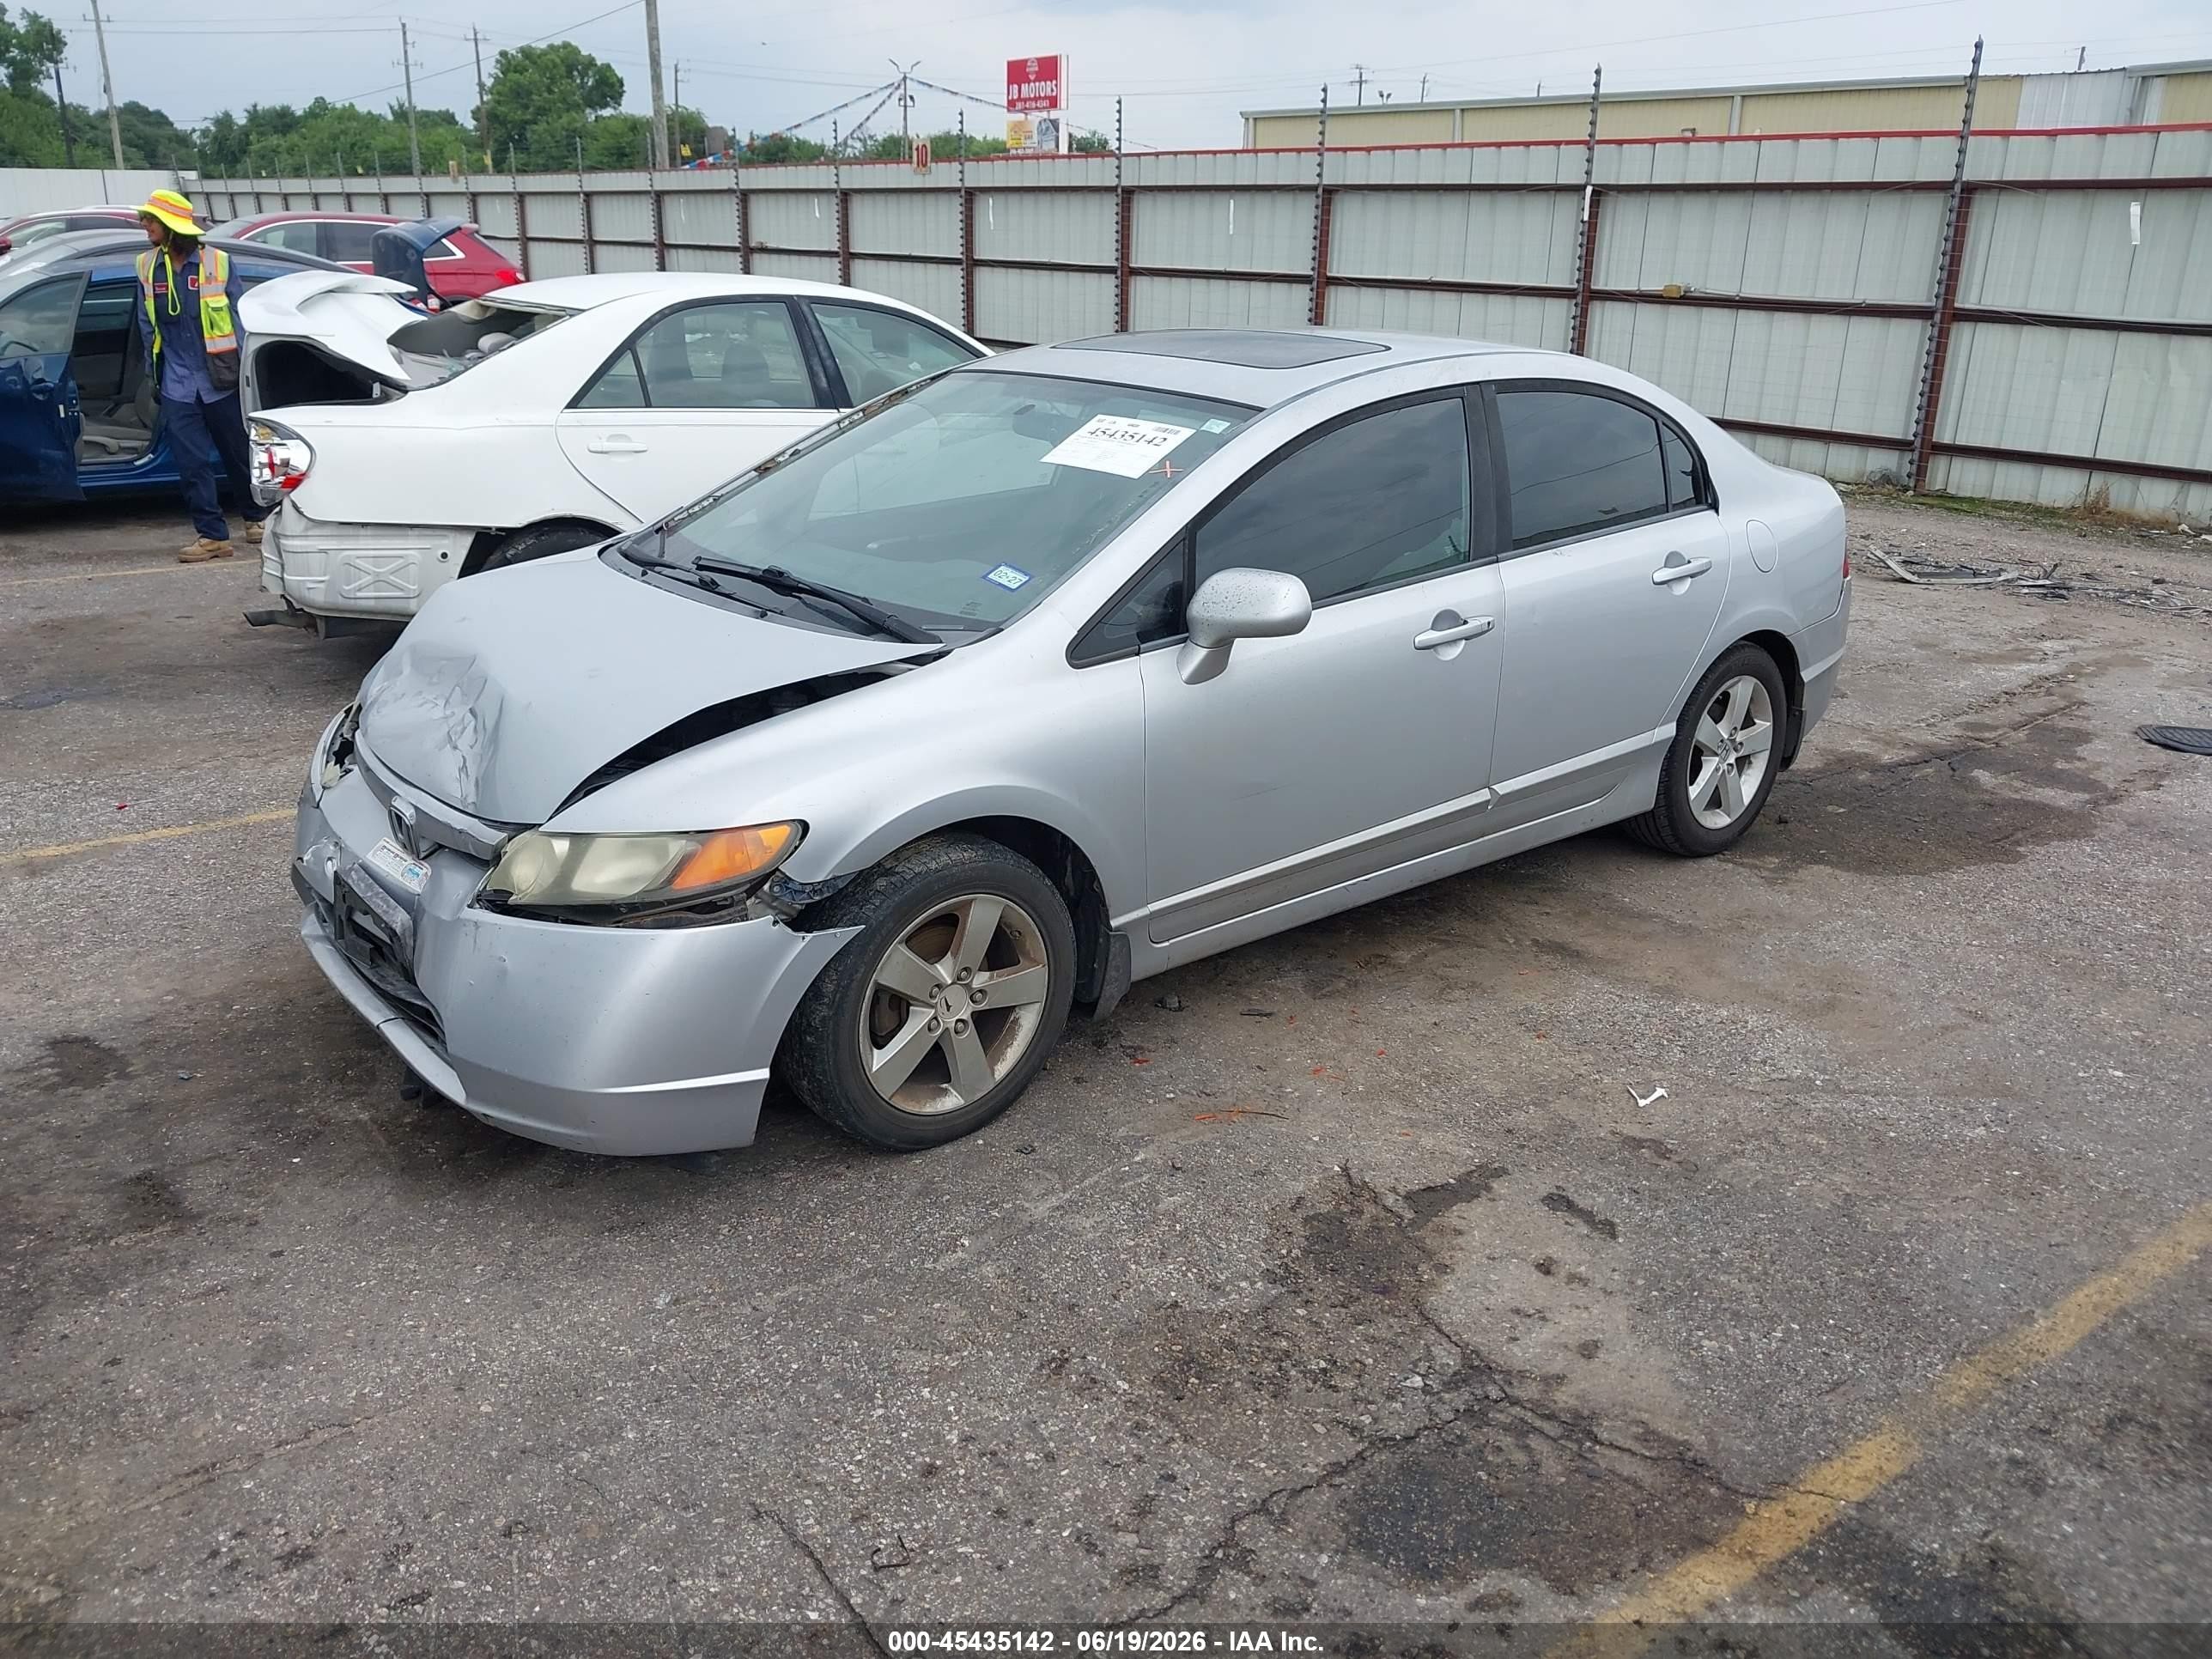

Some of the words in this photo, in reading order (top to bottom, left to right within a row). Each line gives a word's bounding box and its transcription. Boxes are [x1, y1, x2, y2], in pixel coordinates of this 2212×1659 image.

[1009, 84, 1019, 100] JB
[1020, 81, 1057, 98] MOTORS
[915, 143, 928, 167] 10
[1087, 427, 1168, 447] 45435142
